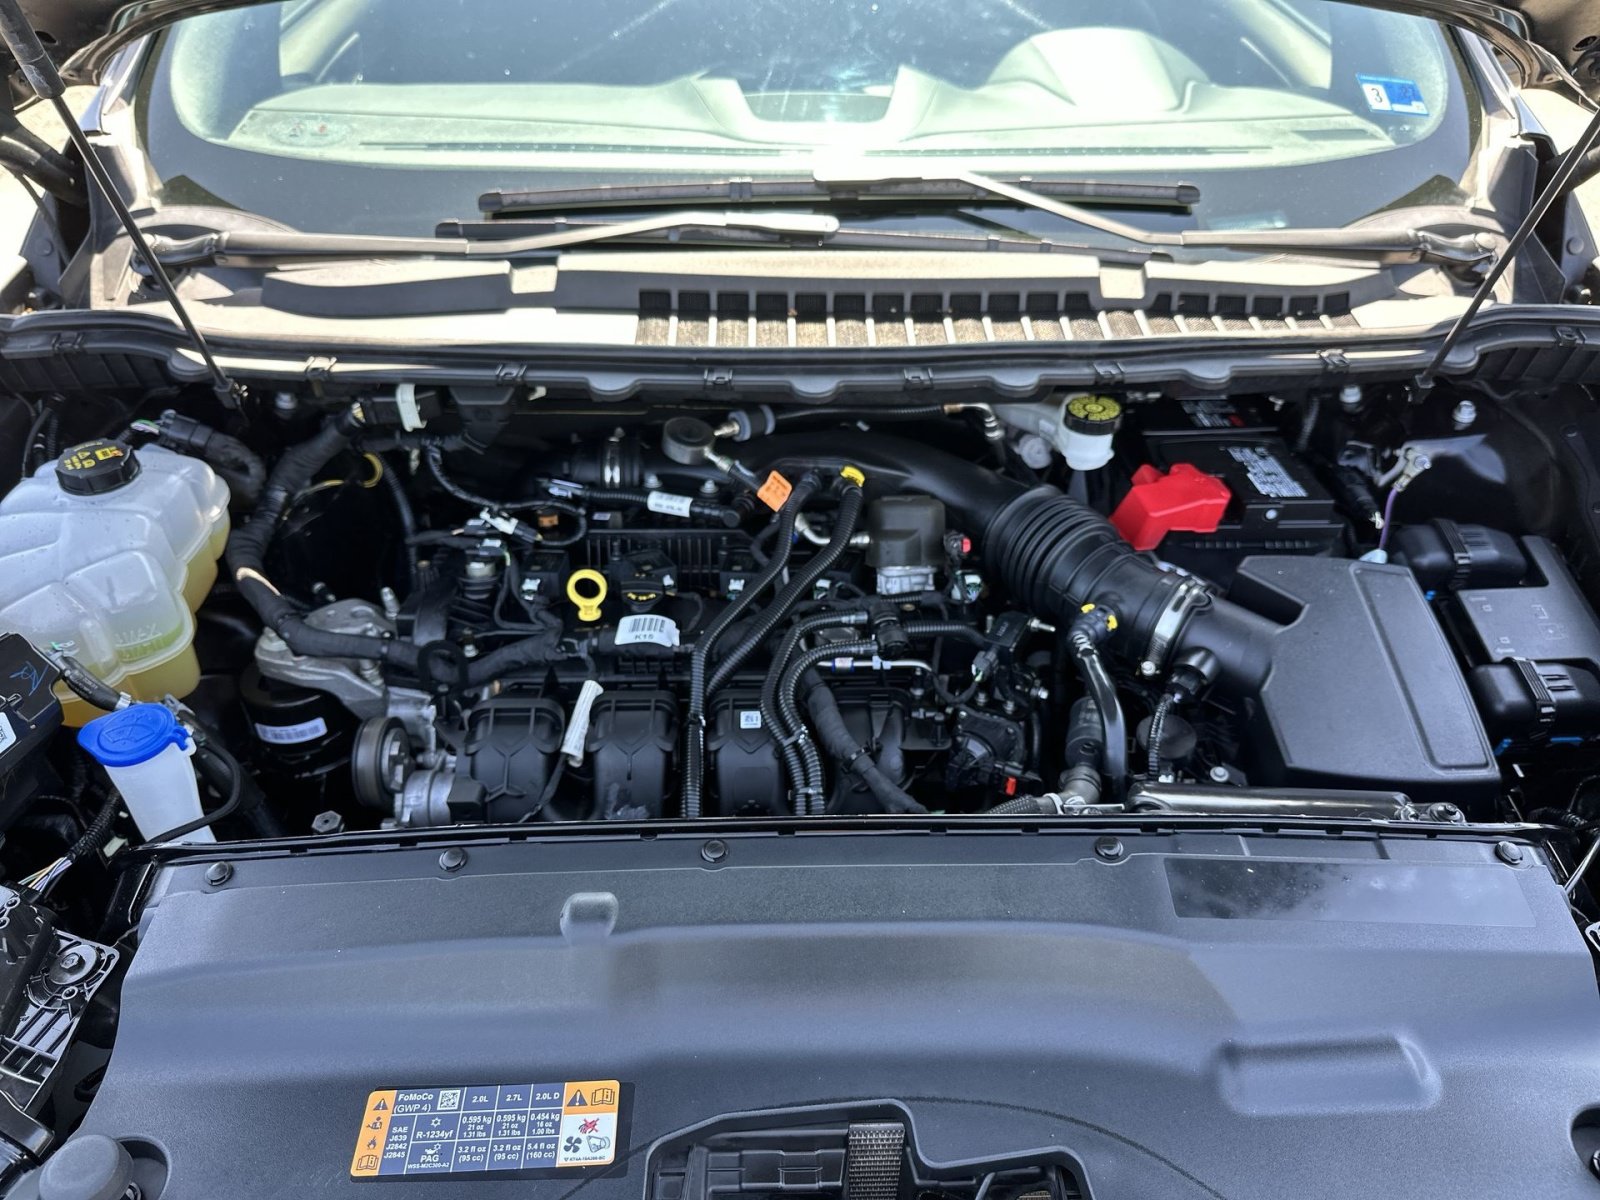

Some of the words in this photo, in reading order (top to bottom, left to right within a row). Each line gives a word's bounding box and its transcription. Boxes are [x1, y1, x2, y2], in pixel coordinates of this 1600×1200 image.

[1371, 87, 1383, 103] 3
[398, 1093, 434, 1101] FoMoCo
[472, 1095, 489, 1103] 2.0L
[506, 1094, 523, 1102] 2.7L
[394, 1104, 421, 1114] (GWP
[421, 1103, 432, 1113] 4)
[462, 1116, 481, 1124] 0.595
[482, 1115, 492, 1124] kg
[496, 1114, 516, 1122] 0.595
[517, 1114, 527, 1123] kg
[530, 1112, 550, 1121] 0.454
[550, 1112, 560, 1122] kg
[416, 1130, 454, 1139] R-1234yf
[420, 1154, 440, 1163] PAG
[458, 1154, 471, 1163] (95
[472, 1154, 484, 1162] cc)
[494, 1153, 506, 1162] (95
[507, 1152, 519, 1160] cc)
[526, 1152, 542, 1160] (160
[543, 1151, 556, 1159] cc)
